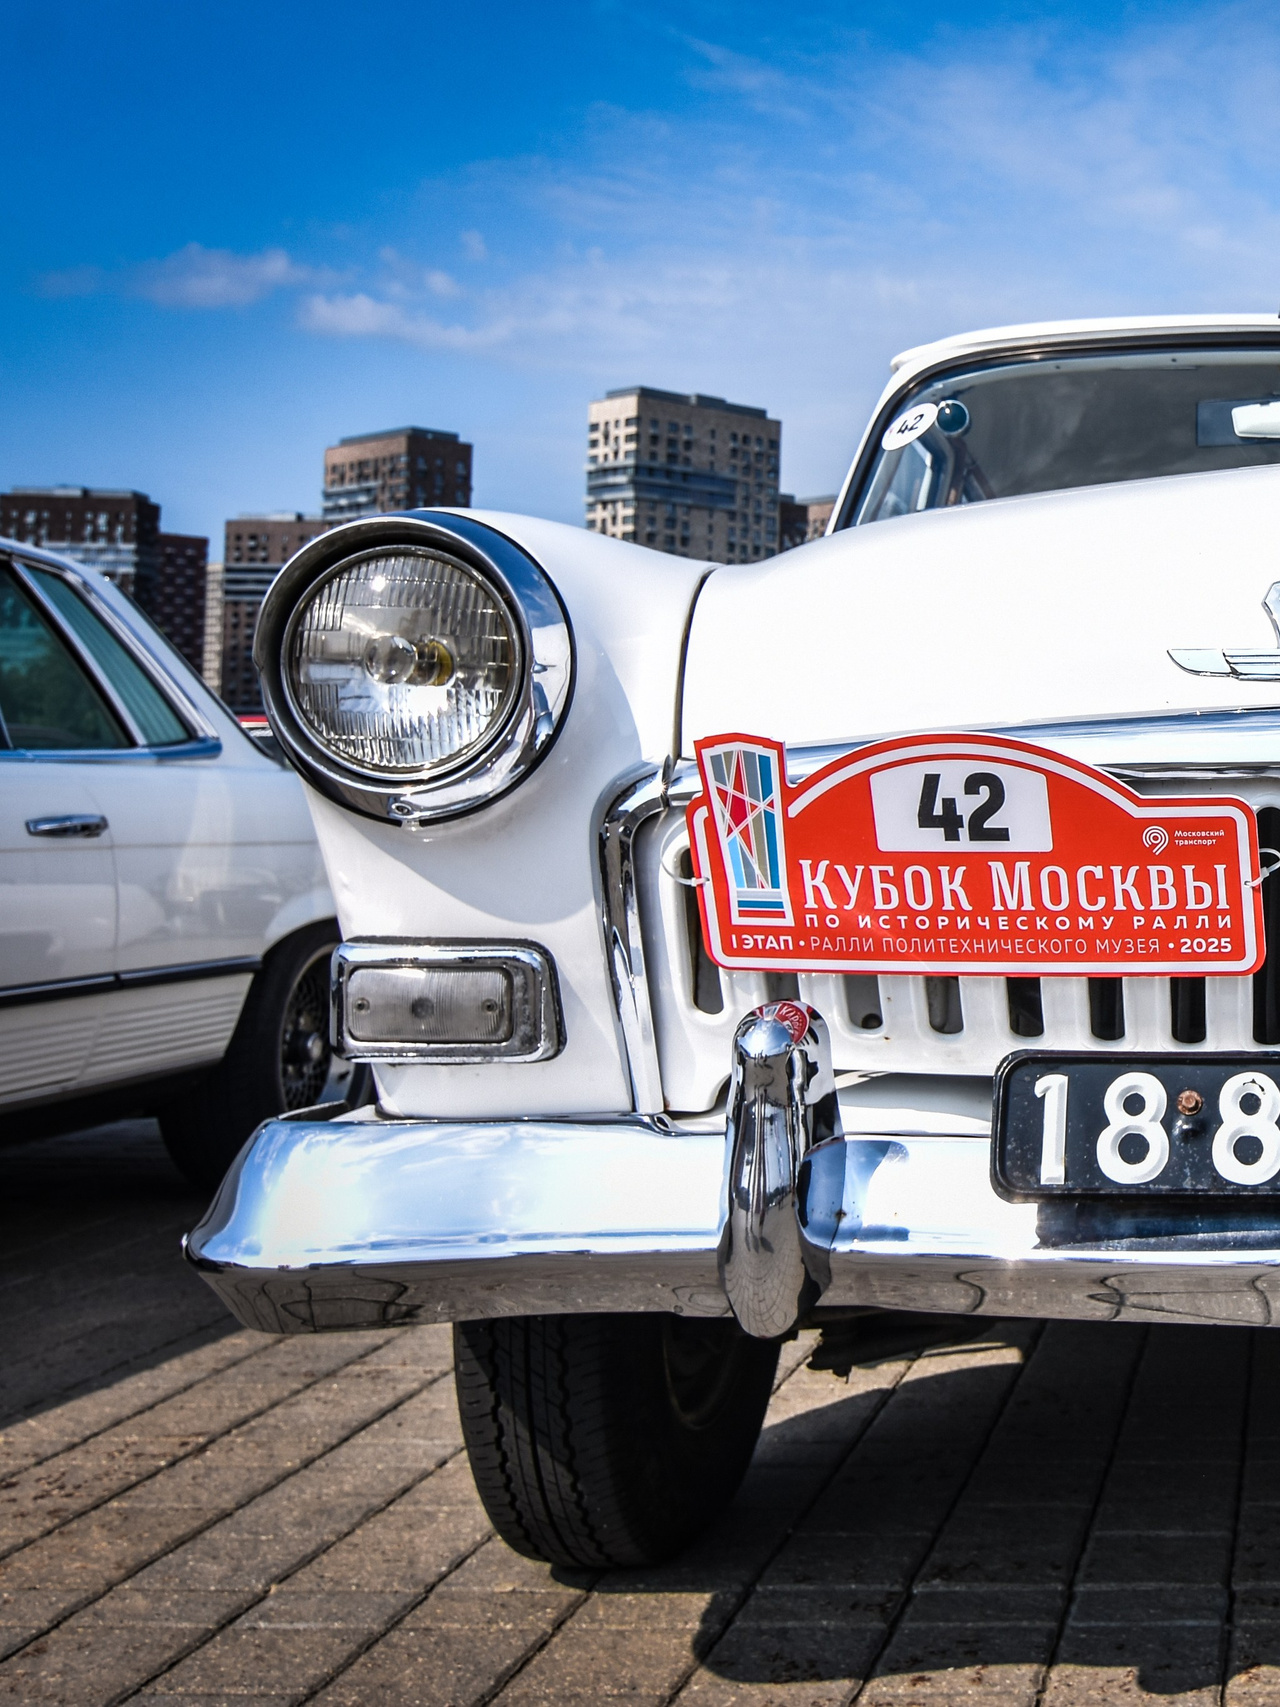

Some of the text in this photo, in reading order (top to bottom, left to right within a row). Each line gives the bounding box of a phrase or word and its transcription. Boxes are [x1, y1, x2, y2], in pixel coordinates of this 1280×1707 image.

[896, 413, 925, 435] 42
[917, 772, 1011, 842] 42
[1174, 829, 1225, 837] Московский
[804, 913, 1232, 931] ПО ИСТОРИЧЕСКОМУ РАЛЛИ
[742, 935, 794, 950] ЭТАП
[810, 937, 874, 952] РАЛЛИ
[882, 937, 1087, 954] ПОЛИТЕХНИЧЕСКОГО
[1095, 938, 1160, 954] МУЗЕЯ
[1179, 937, 1232, 953] 2025
